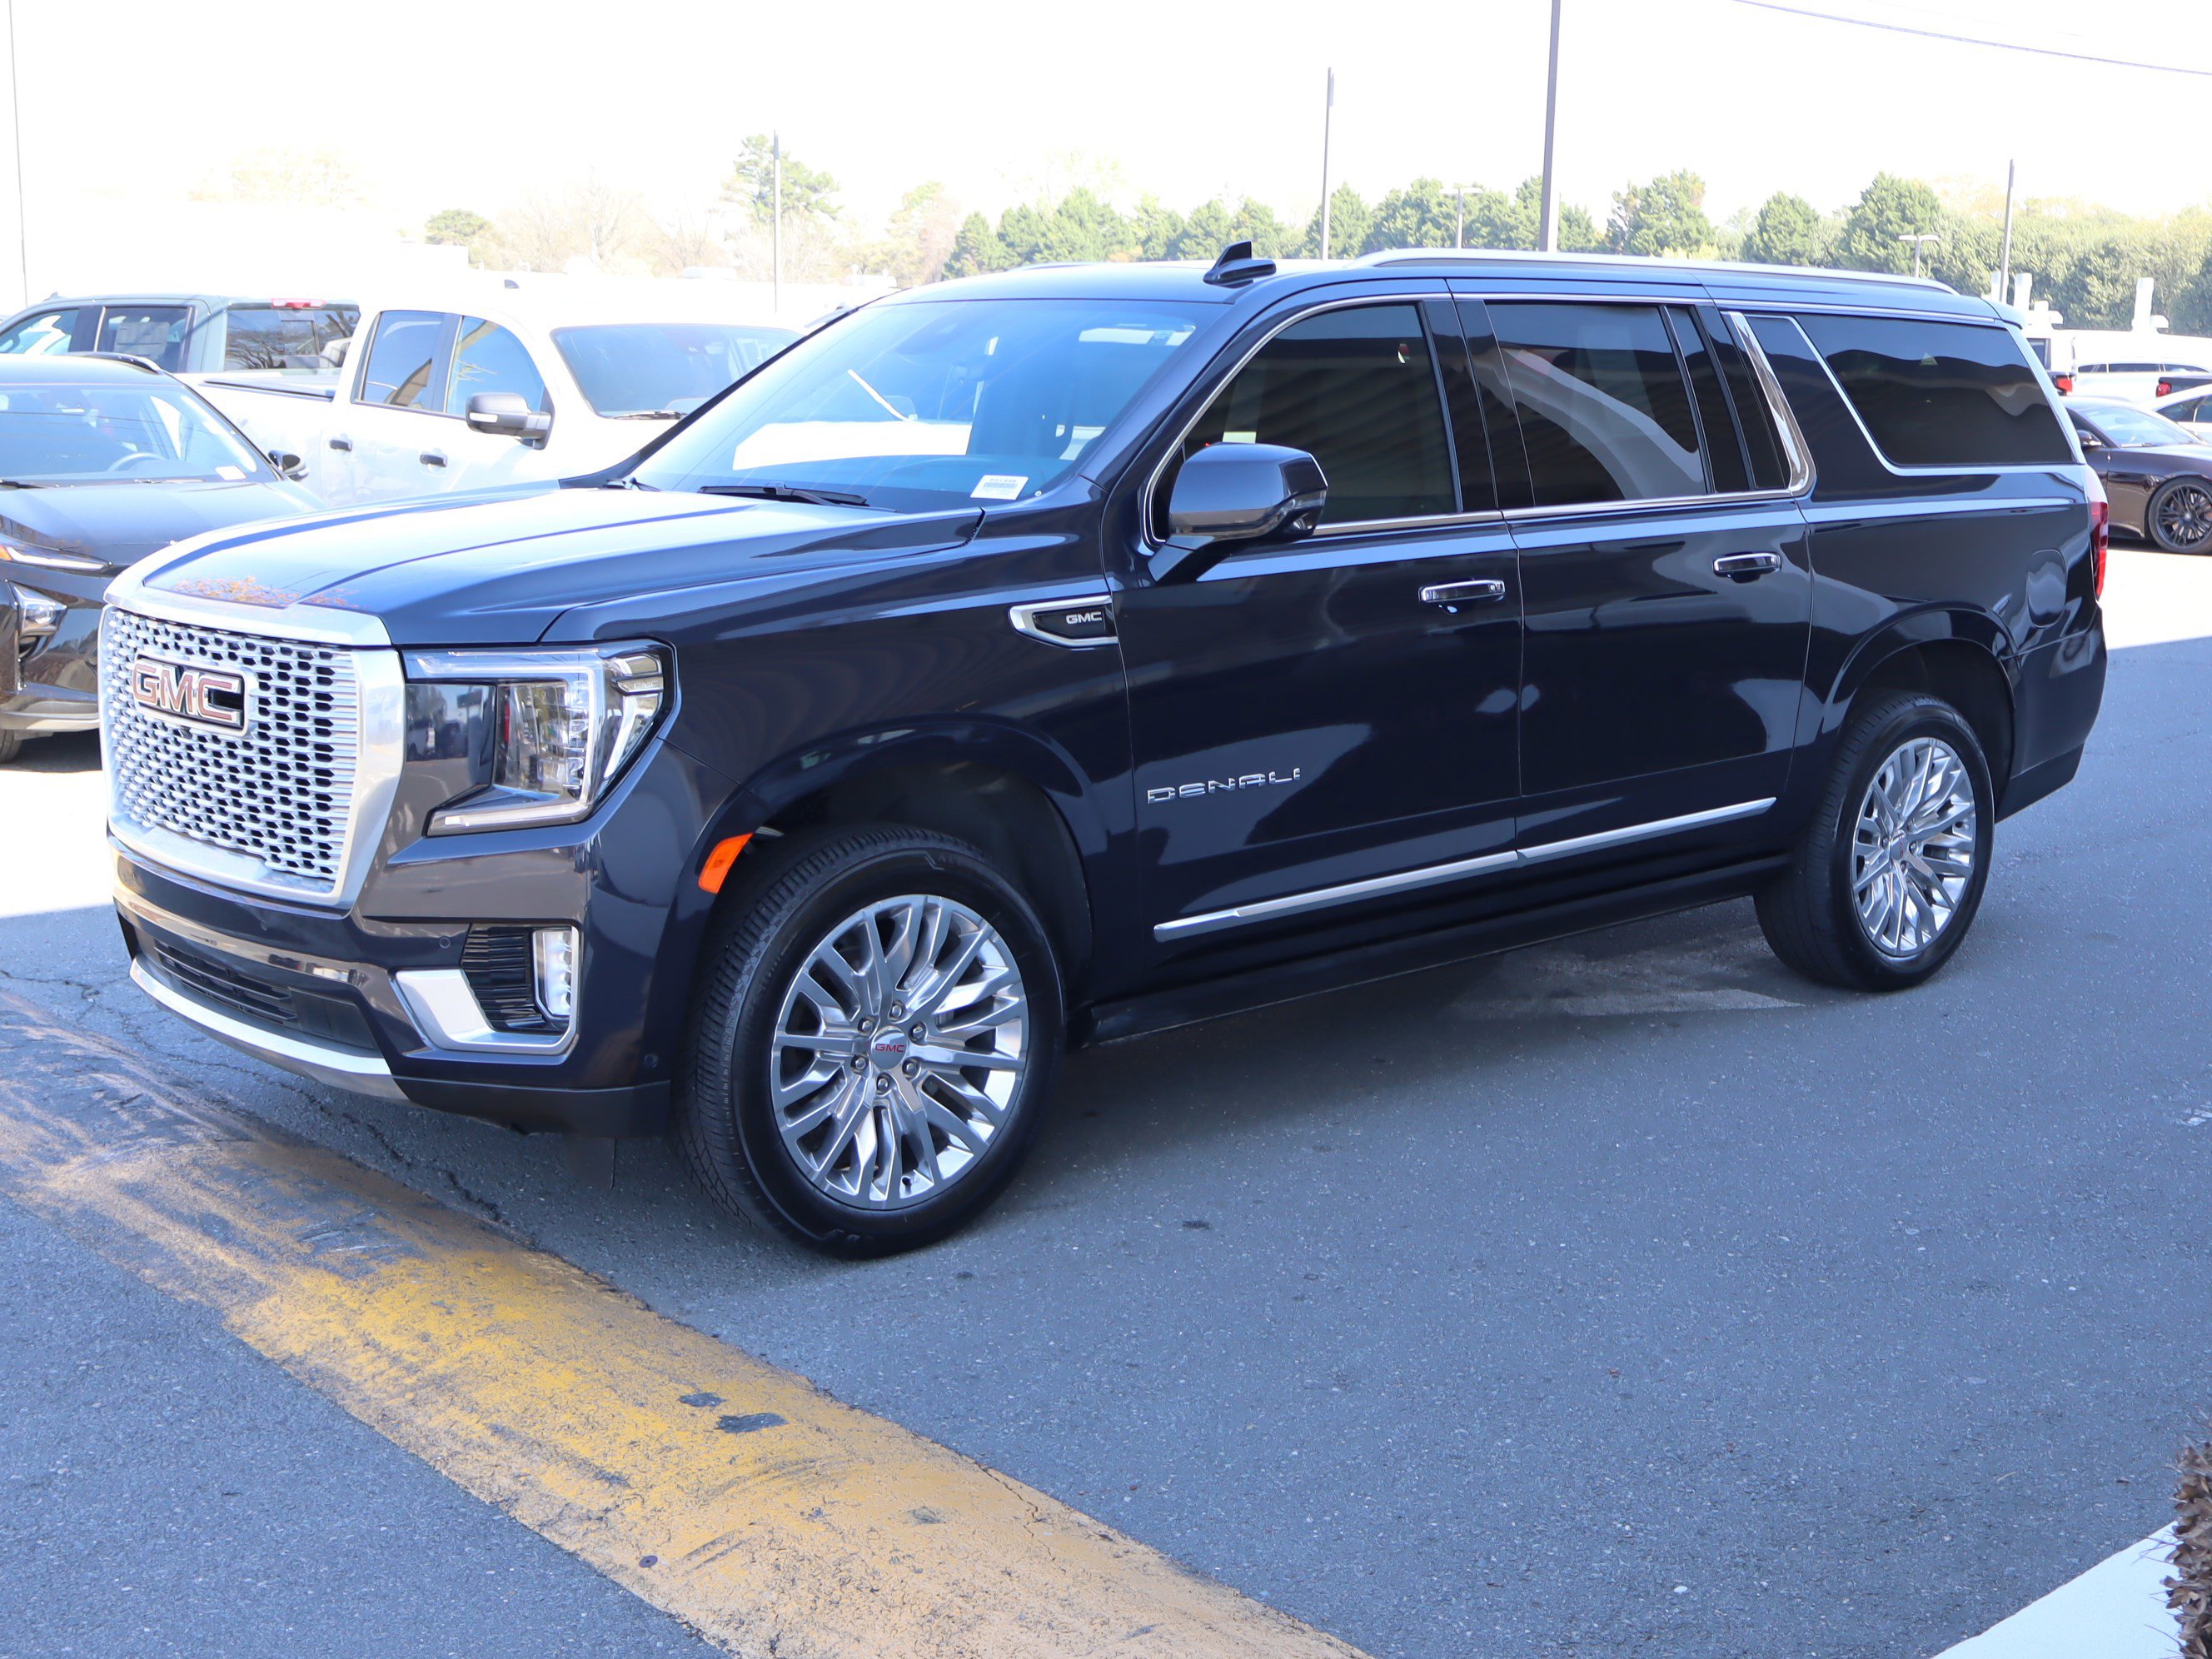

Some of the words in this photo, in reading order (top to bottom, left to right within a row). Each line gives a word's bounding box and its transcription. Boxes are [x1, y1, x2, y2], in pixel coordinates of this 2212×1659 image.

[1066, 611, 1103, 625] GMC
[132, 661, 240, 725] GMC
[1147, 767, 1301, 805] DENALI
[874, 1043, 905, 1053] GMC
